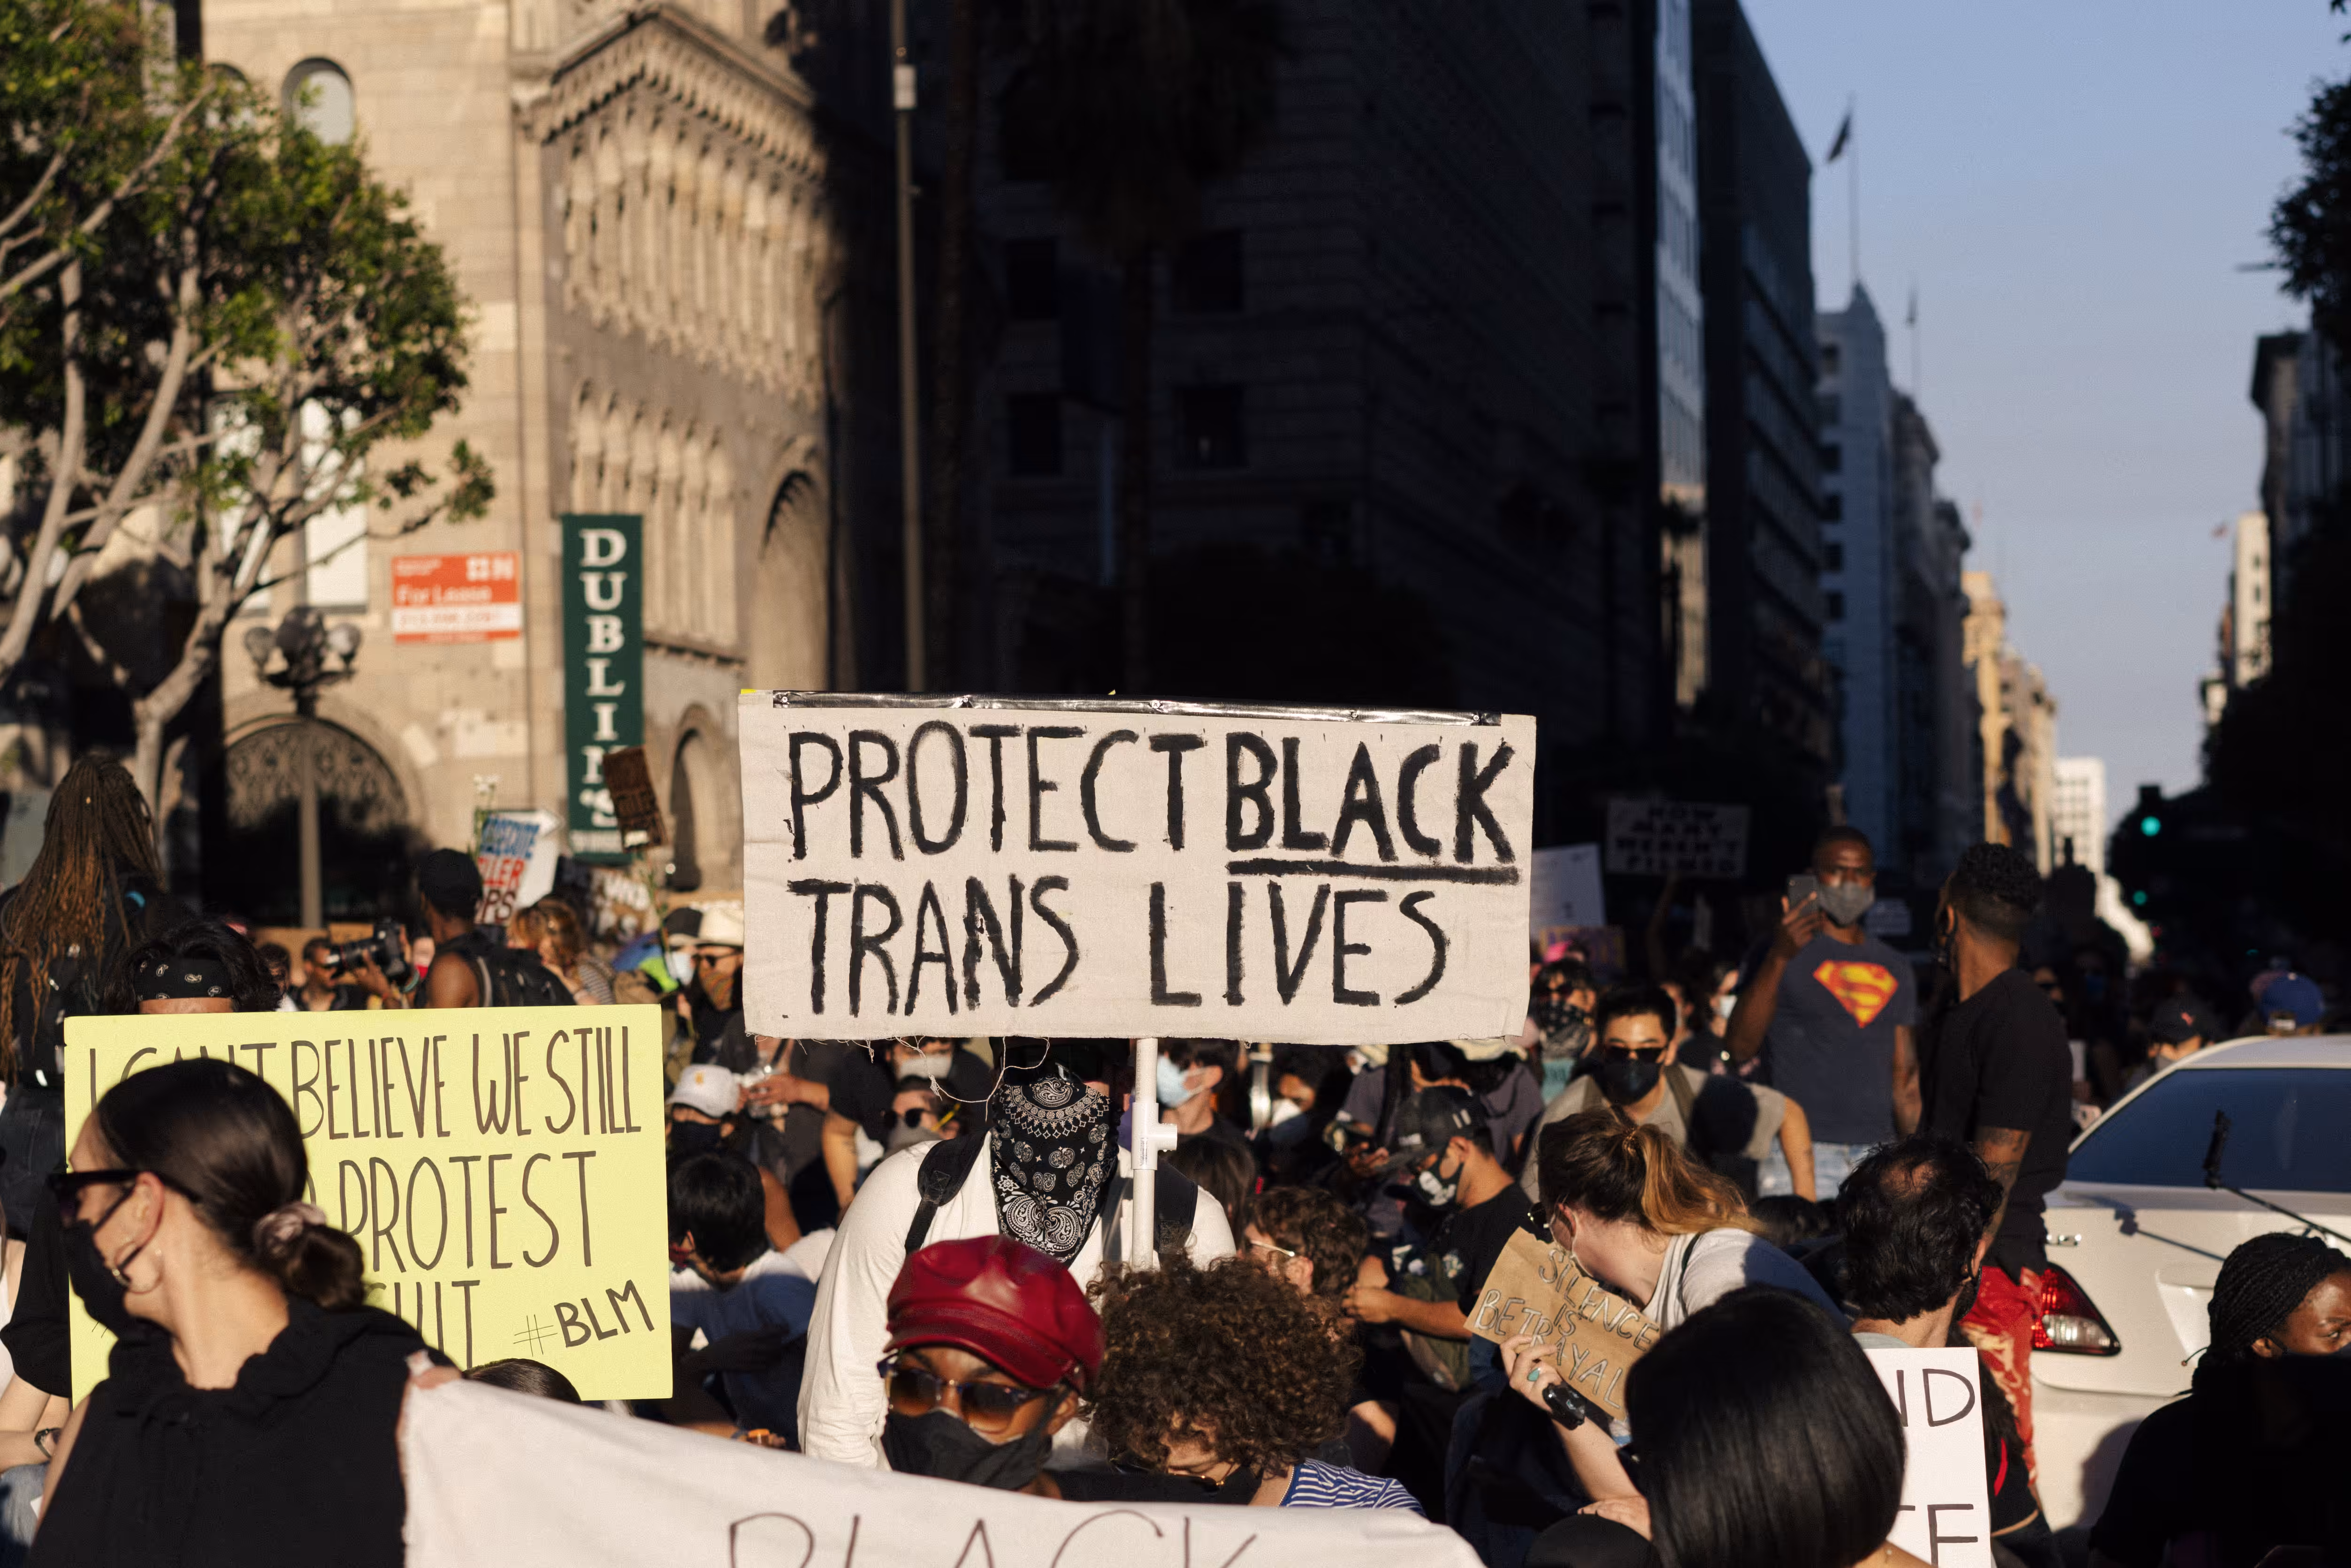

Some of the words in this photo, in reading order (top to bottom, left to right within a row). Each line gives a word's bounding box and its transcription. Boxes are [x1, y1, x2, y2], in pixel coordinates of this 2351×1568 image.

[783, 720, 1205, 861] PROTECT
[1225, 732, 1516, 865] BLACK
[786, 874, 1080, 1018] TRANS
[1148, 879, 1451, 1007] LIVES
[291, 1035, 450, 1140] BELIEVE
[472, 1031, 532, 1136] WE
[545, 1026, 641, 1136] STILL
[339, 1150, 596, 1273] PROTEST
[513, 1279, 655, 1357] #BLM
[1473, 1289, 1623, 1410] BETRAYAL
[1538, 1246, 1660, 1352] SILENCE
[1553, 1303, 1577, 1337] IS
